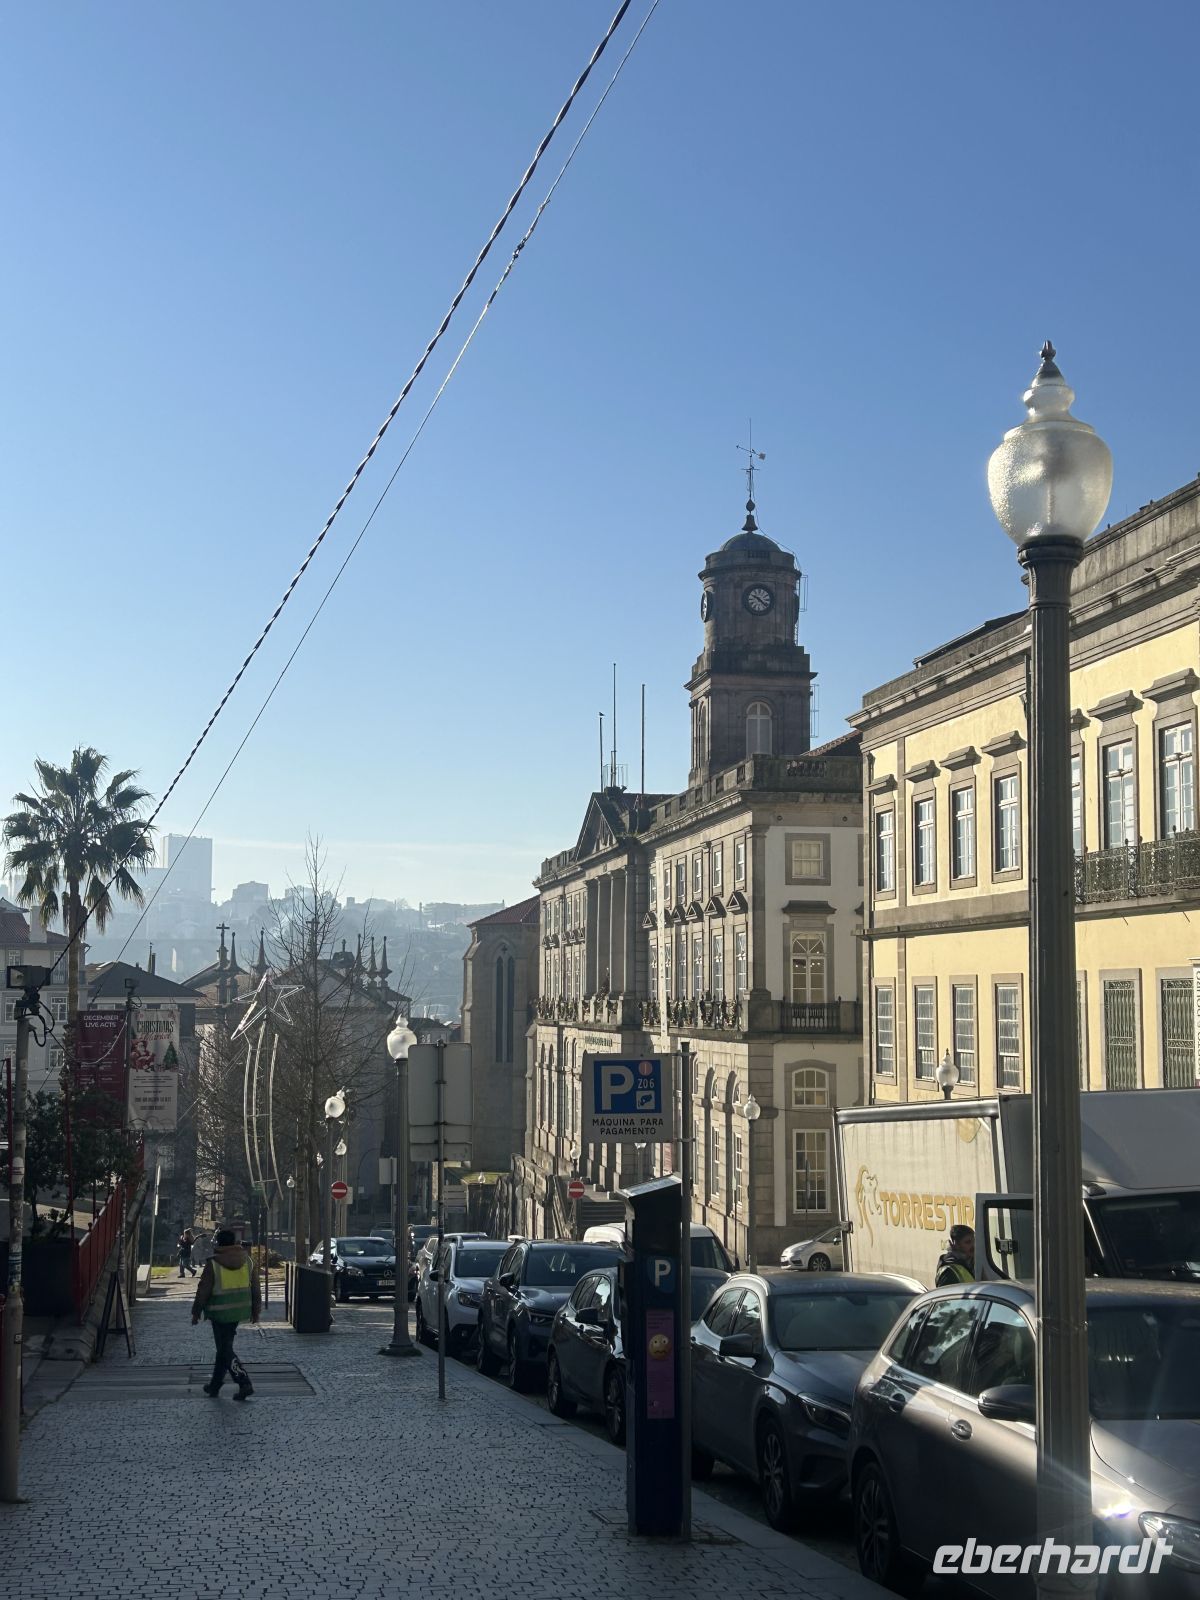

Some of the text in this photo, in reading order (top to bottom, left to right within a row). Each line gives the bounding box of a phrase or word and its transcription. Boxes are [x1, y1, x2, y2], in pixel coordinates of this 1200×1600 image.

[136, 1020, 174, 1033] CHRISTMAS
[601, 1066, 635, 1111] P
[600, 1127, 657, 1135] PAGAMENTO
[640, 1118, 664, 1126] PARA
[879, 1192, 975, 1232] TORRESTIR
[654, 1259, 672, 1287] P
